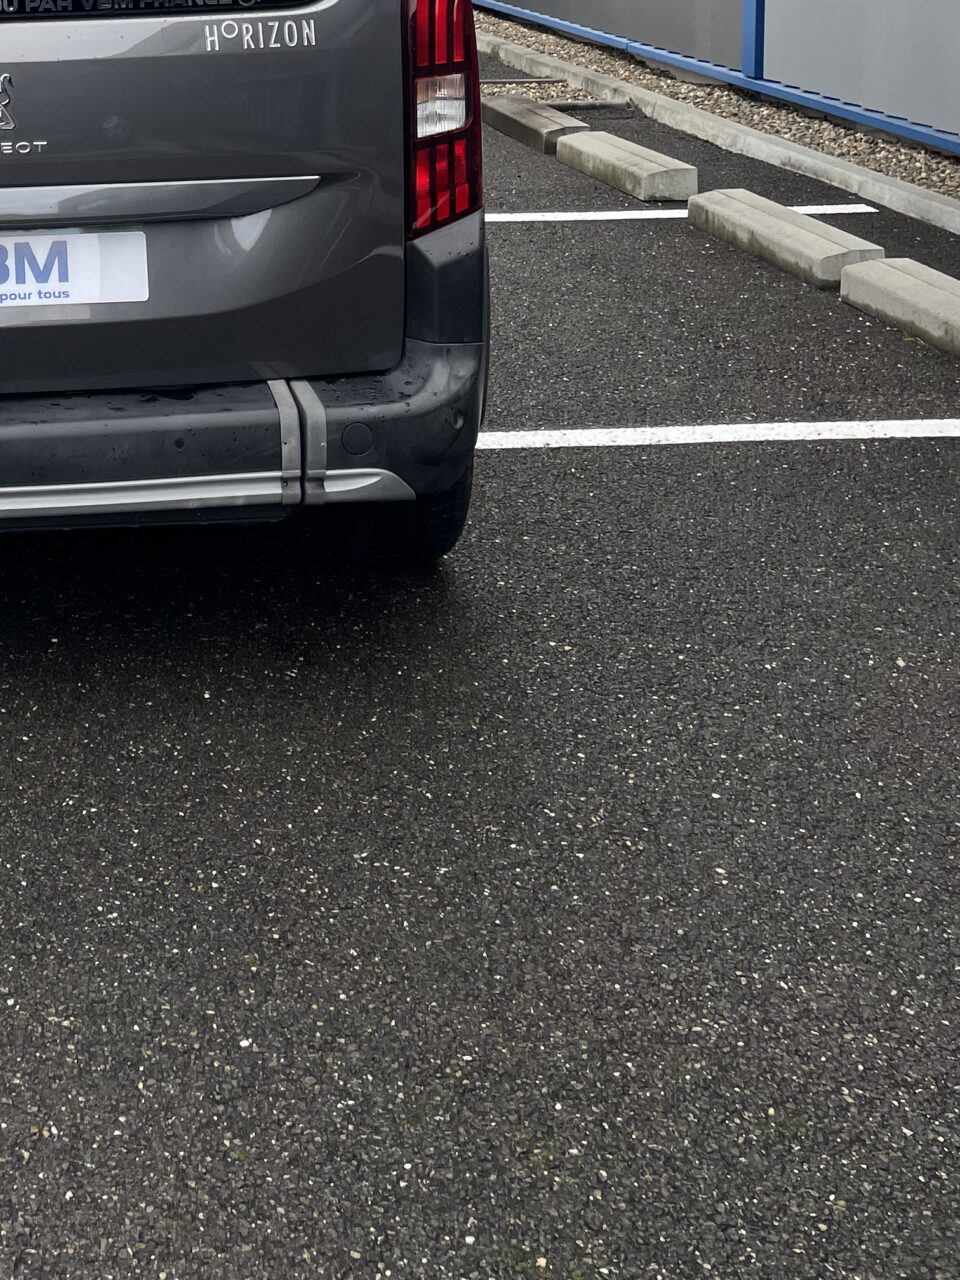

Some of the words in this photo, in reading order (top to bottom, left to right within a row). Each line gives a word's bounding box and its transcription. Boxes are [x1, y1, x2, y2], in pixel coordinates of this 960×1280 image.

[204, 20, 316, 51] HORIZON
[0, 291, 33, 304] pour
[37, 288, 70, 300] tous
